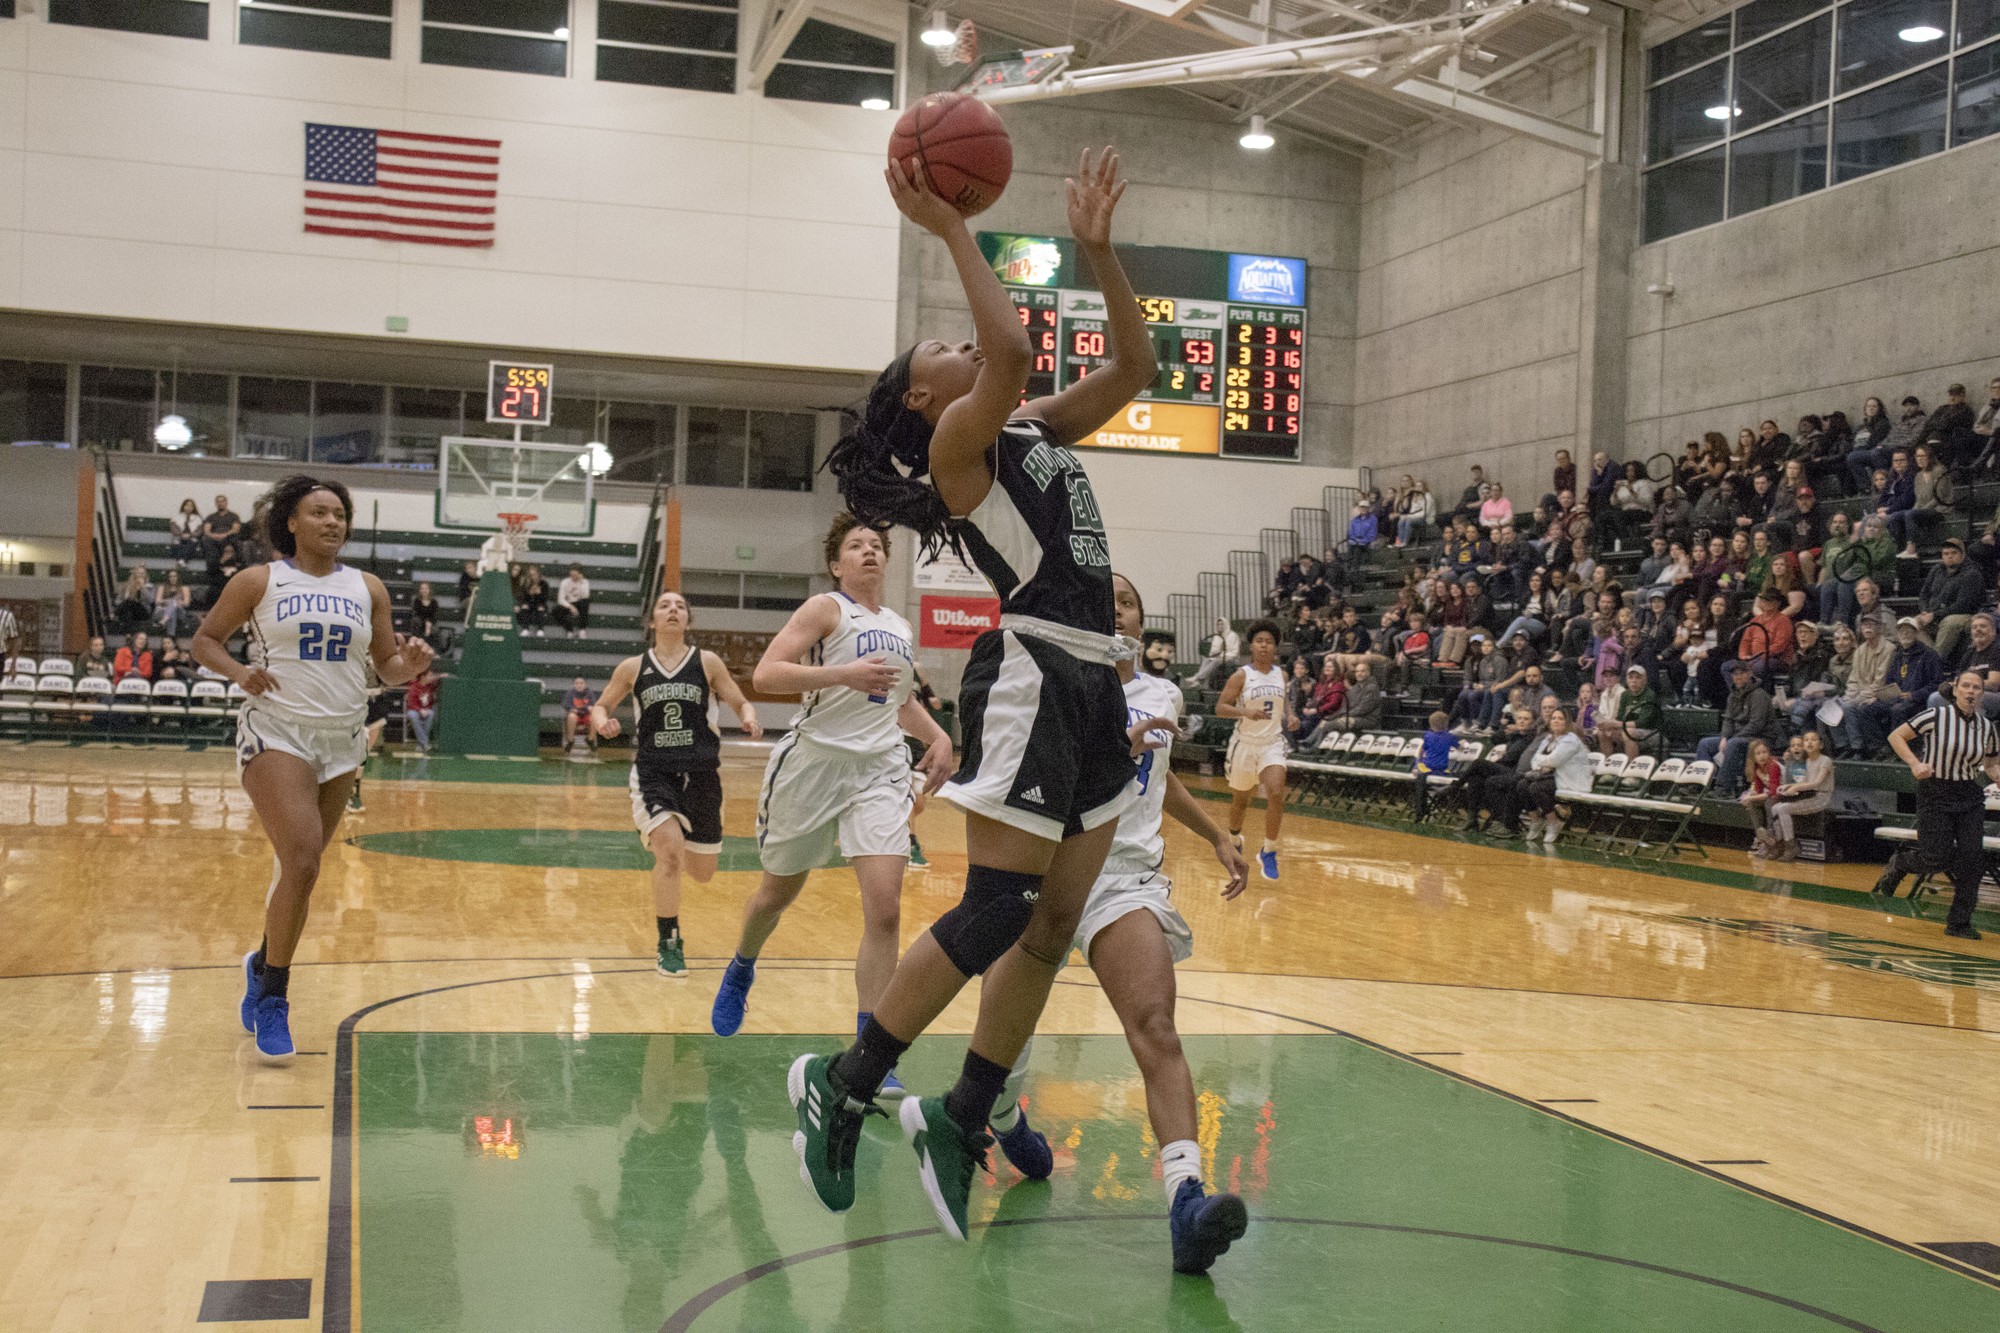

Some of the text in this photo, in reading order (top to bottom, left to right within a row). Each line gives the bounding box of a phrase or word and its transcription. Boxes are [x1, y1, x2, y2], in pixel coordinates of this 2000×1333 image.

[1010, 292, 1055, 305] FLS PTS
[1043, 309, 1056, 327] 4
[1136, 298, 1175, 322] :59
[1230, 309, 1253, 321] PLYR
[1257, 311, 1275, 322] FLS
[1282, 313, 1300, 325] PTS
[1072, 320, 1103, 331] JACKS
[1181, 328, 1214, 340] GUEST
[1239, 324, 1302, 345] 2 3 4
[1042, 331, 1055, 350] 6
[1075, 331, 1104, 356] 60
[1036, 353, 1055, 372] 17
[1185, 340, 1214, 365] 53
[1239, 346, 1300, 368] 3 3 16
[508, 368, 548, 387] 5:59
[1171, 371, 1213, 391] 2 2
[1226, 368, 1300, 389] 22 3 4
[501, 386, 539, 417] 27
[1225, 390, 1250, 409] 23
[1263, 392, 1275, 411] 3
[1286, 394, 1299, 412] 8
[1127, 404, 1151, 430] G
[1225, 412, 1298, 434] 24 1 5
[1096, 431, 1182, 450] GATORADE
[1065, 475, 1105, 532] 20
[277, 593, 364, 628] COYOTES
[932, 608, 992, 628] Wilson
[299, 622, 352, 662] 22
[641, 683, 702, 710] HUMBOLDT
[664, 702, 683, 730] 2
[654, 729, 694, 748] STATE
[1020, 791, 1045, 804] adidas
